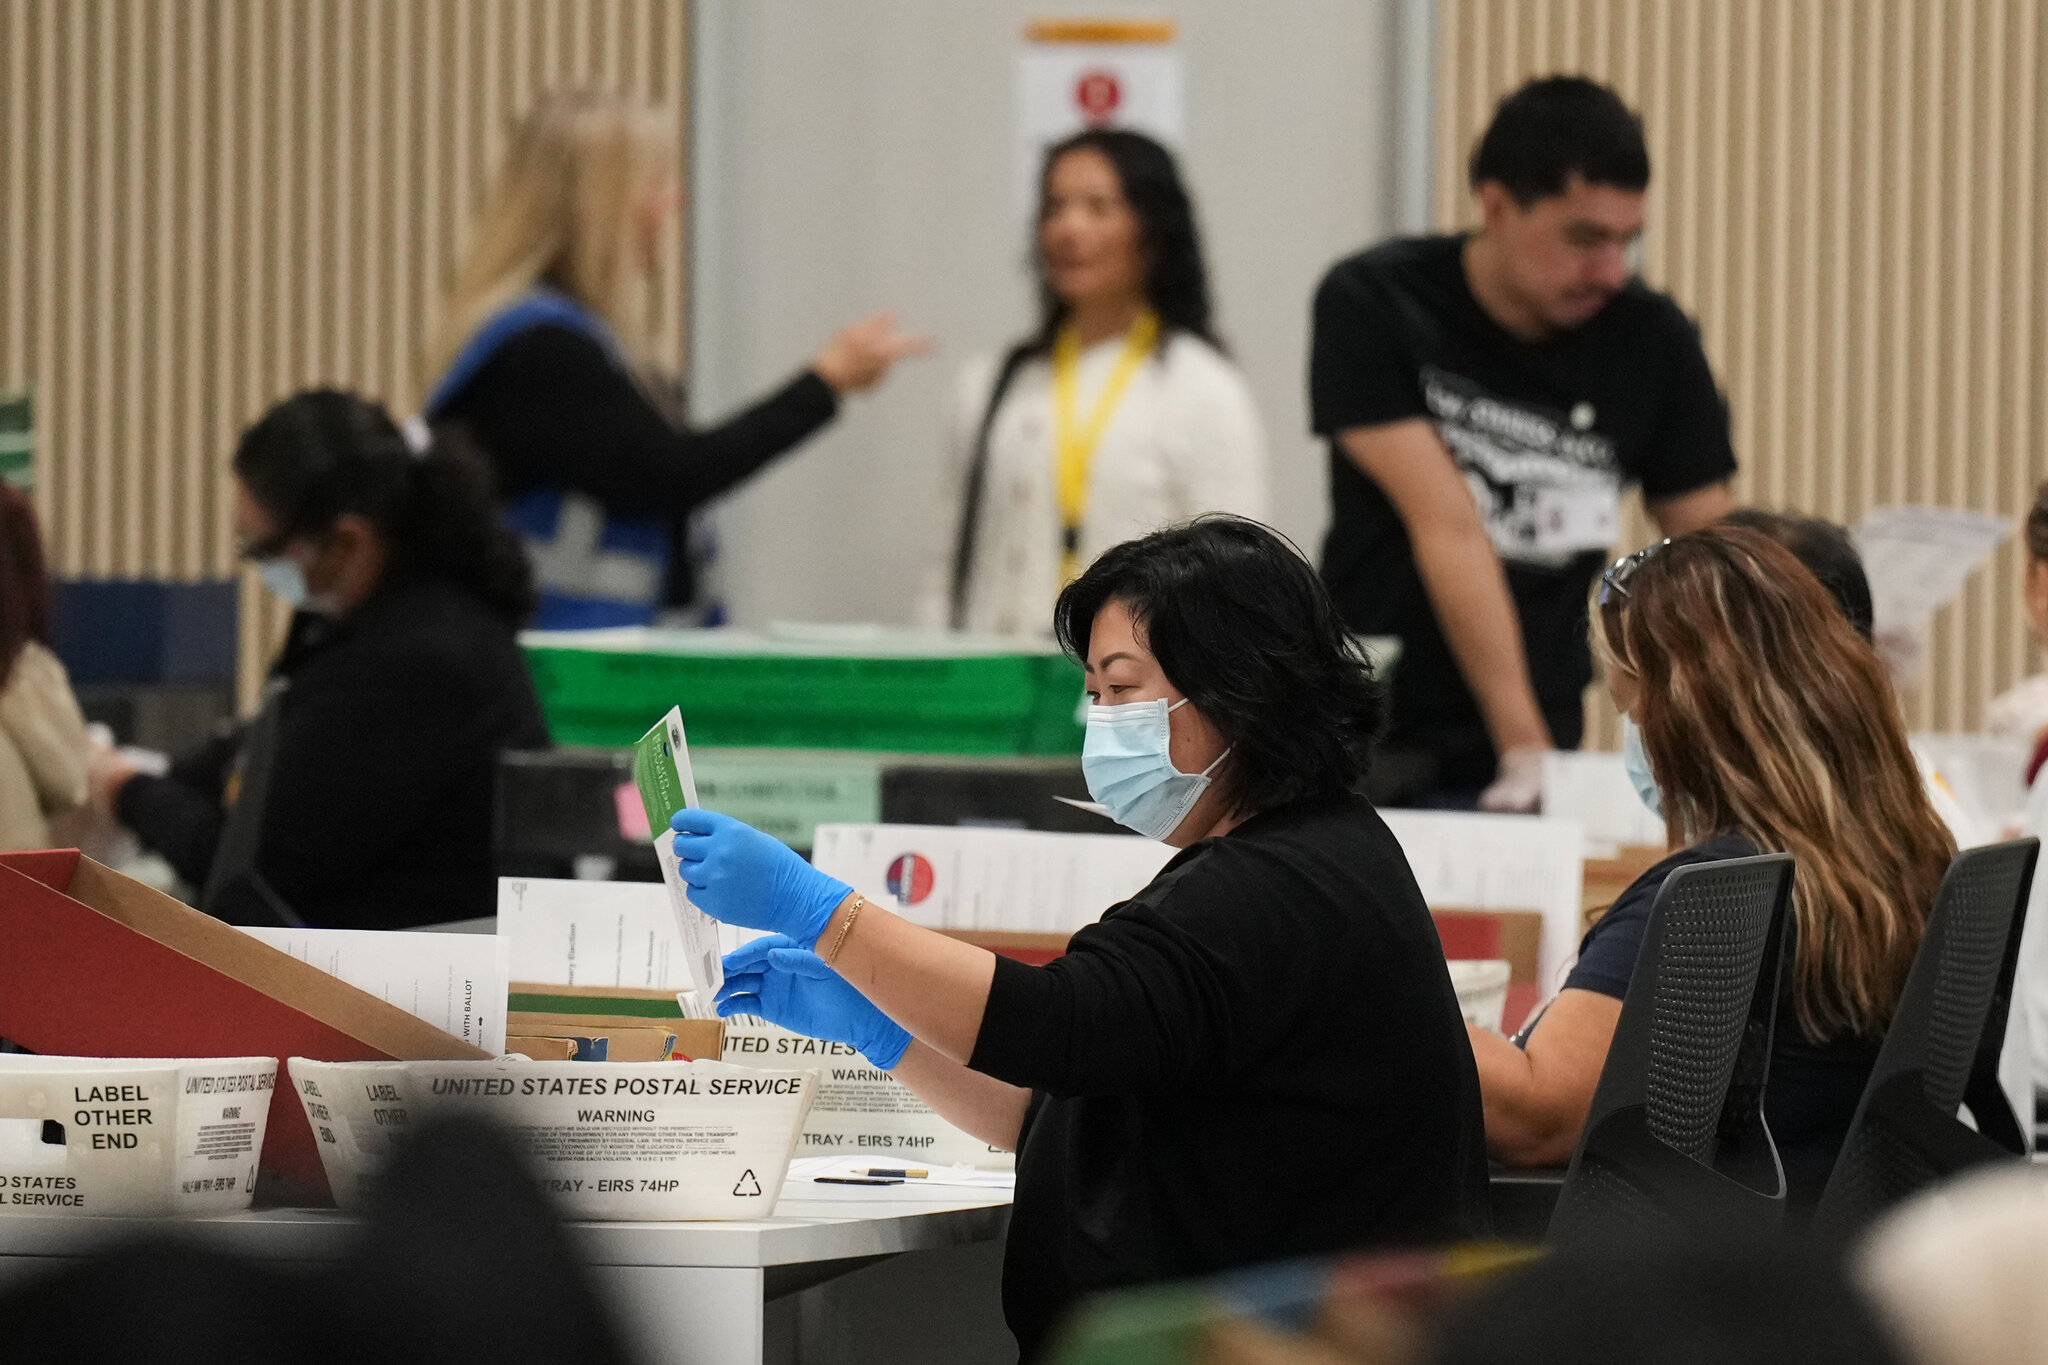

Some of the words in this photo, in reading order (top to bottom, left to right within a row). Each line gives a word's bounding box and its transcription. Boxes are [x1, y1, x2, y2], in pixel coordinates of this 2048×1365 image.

[464, 980, 472, 1012] BALLOT
[463, 1014, 471, 1037] WITH
[723, 1036, 769, 1053] ITED
[776, 1038, 857, 1056] STATES
[832, 1069, 894, 1081] WARNIN
[75, 1085, 149, 1103] LABEL
[300, 1079, 322, 1097] LABEL
[366, 1085, 402, 1101] LABEL
[432, 1077, 515, 1096] UNITED
[521, 1077, 607, 1096] STATES
[615, 1077, 701, 1096] POSTAL
[709, 1077, 801, 1096] SERVICE
[74, 1109, 153, 1127] OTHER
[308, 1101, 332, 1121] OTHER
[373, 1108, 409, 1126] OTHER
[577, 1109, 656, 1123] WARNING
[92, 1133, 138, 1150] END
[802, 1133, 845, 1147] TRAY
[857, 1135, 893, 1148] EIRS
[897, 1136, 935, 1148] 74HP
[11, 1176, 76, 1190] STATES
[542, 1179, 583, 1193] TRAY
[597, 1179, 635, 1193] EIRS
[640, 1179, 679, 1193] 74HP
[12, 1193, 84, 1207] SERVICE
